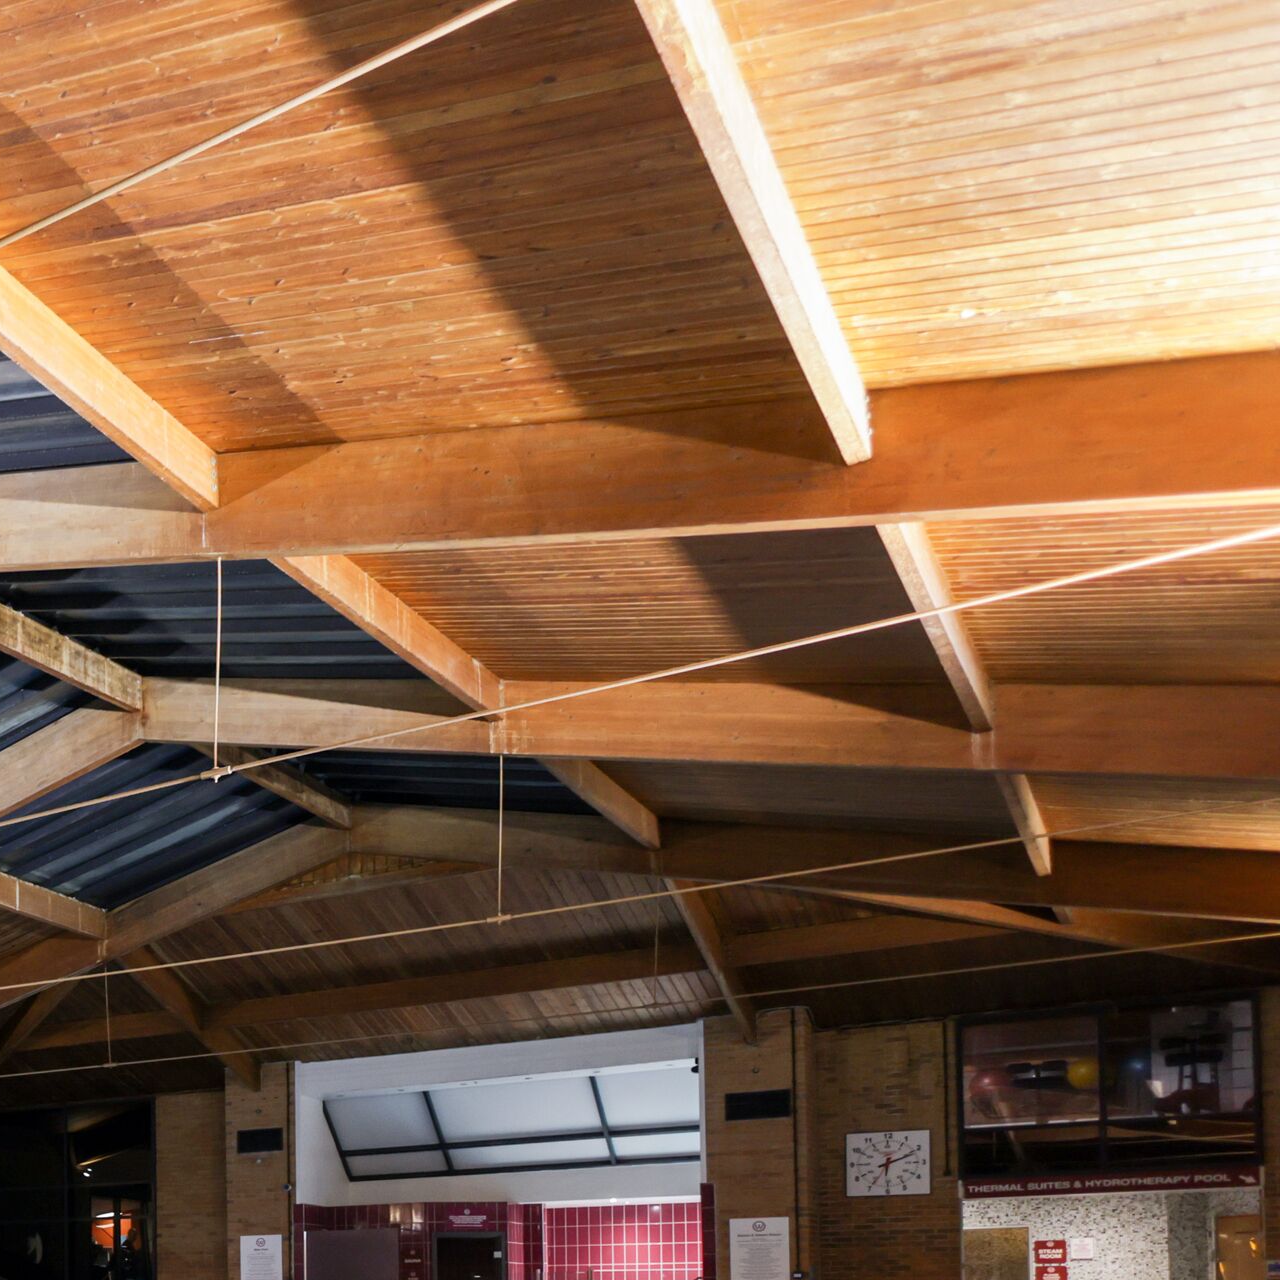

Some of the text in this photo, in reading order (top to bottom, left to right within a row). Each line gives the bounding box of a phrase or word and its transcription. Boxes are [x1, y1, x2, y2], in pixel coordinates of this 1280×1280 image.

[968, 1174, 1230, 1193] THERMAL SUITES & HYDROTHERAPY POOL
